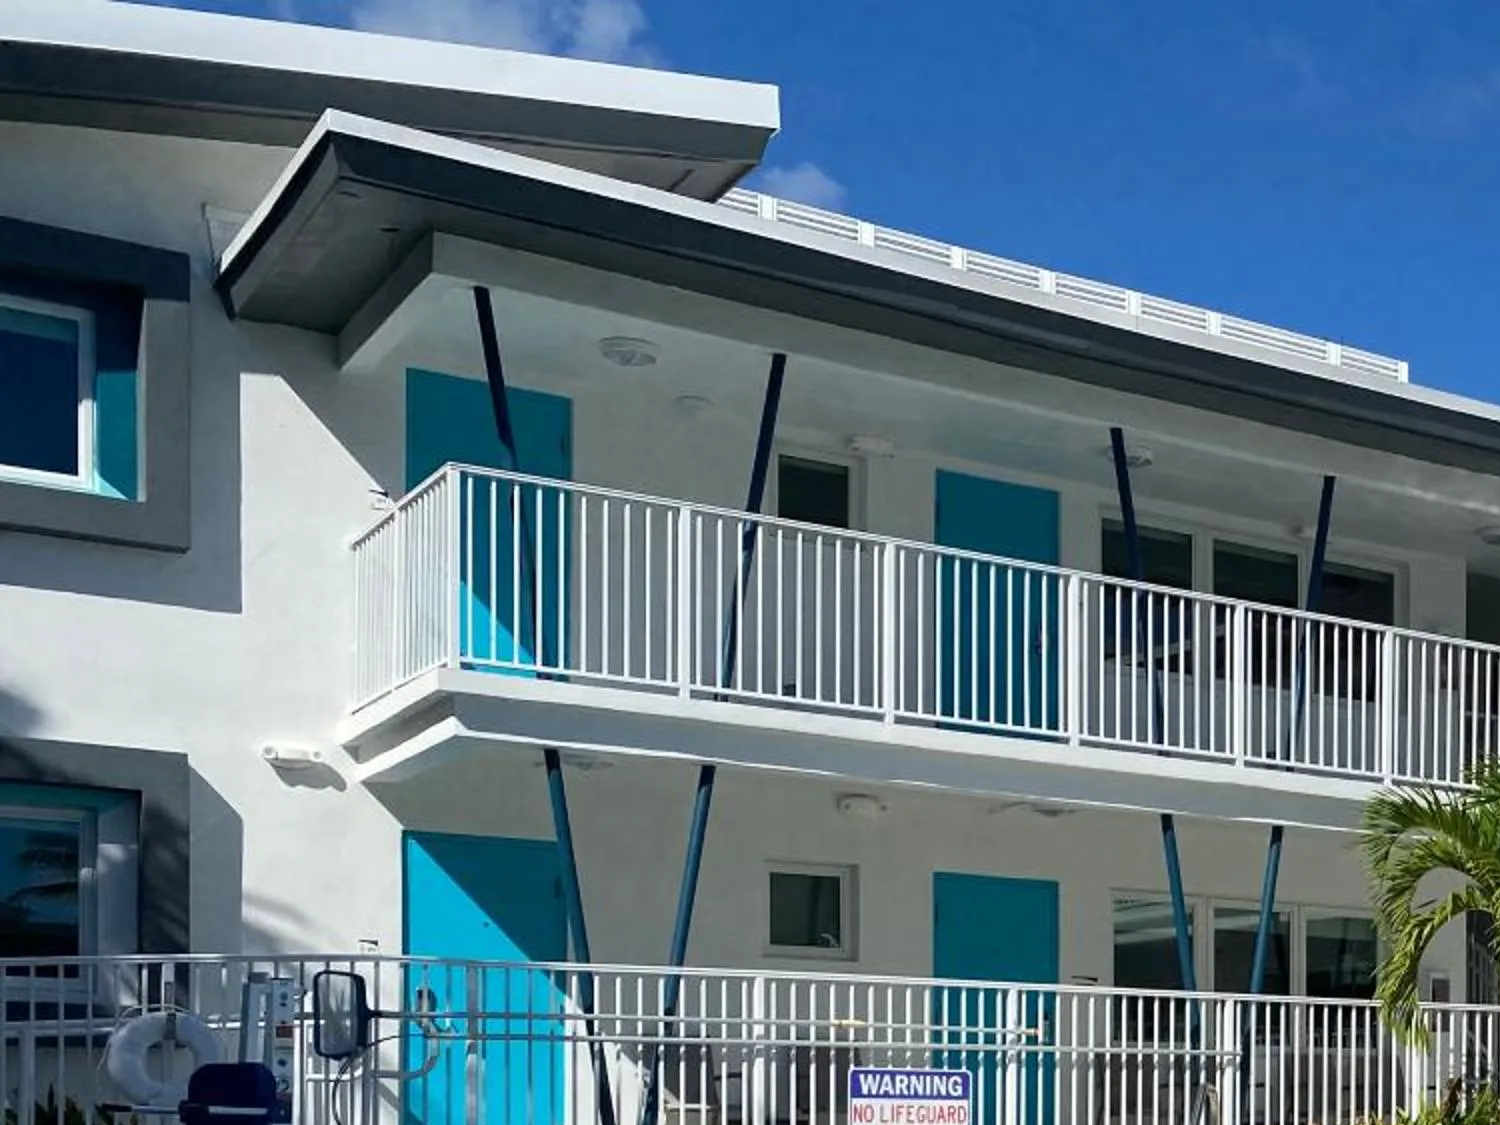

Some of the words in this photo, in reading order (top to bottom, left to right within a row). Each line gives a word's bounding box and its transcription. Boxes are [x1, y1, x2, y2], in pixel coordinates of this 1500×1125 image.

[859, 1073, 963, 1096] WARNING
[853, 1103, 875, 1123] NO
[879, 1104, 967, 1124] LIFEGUARD
